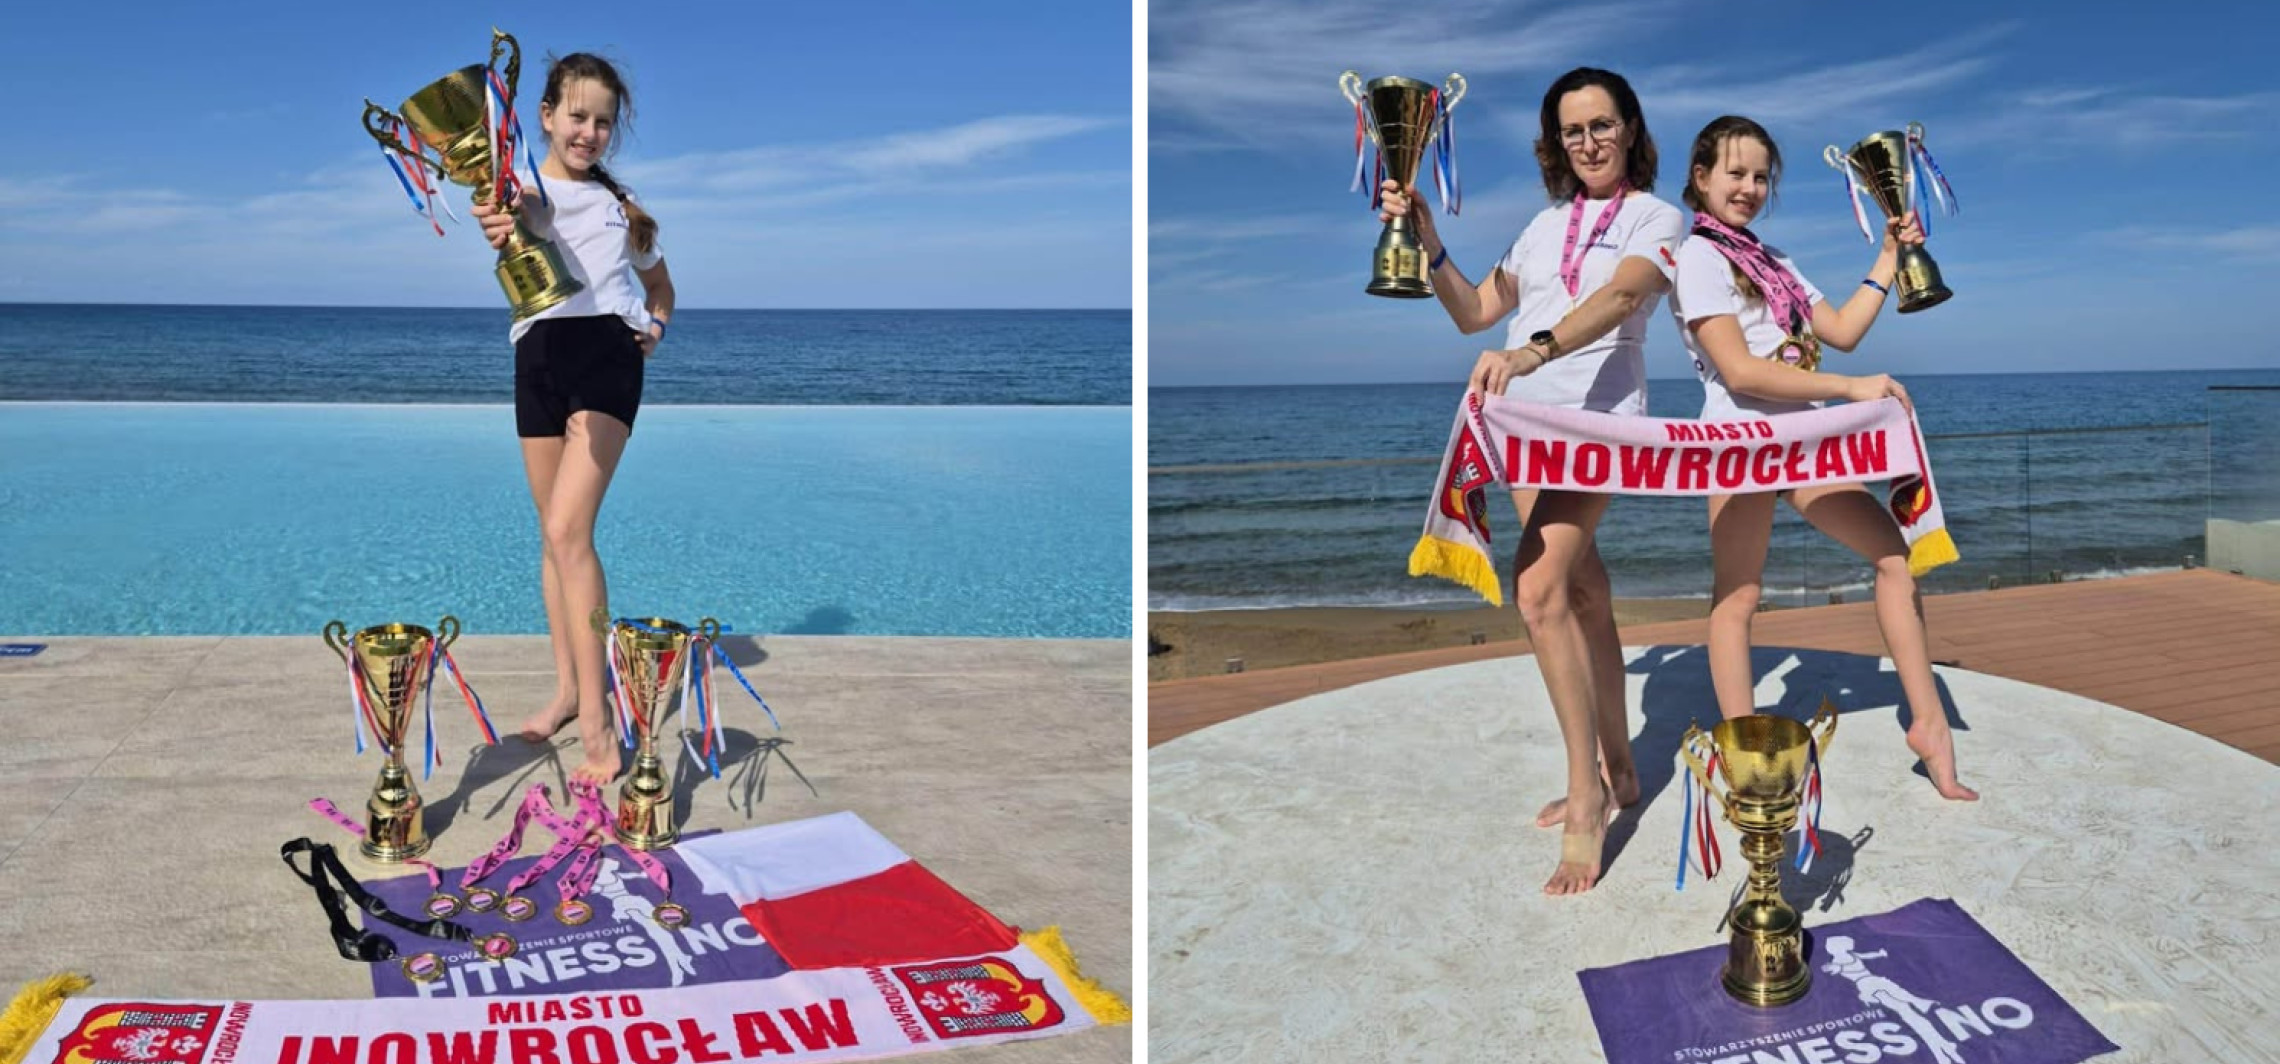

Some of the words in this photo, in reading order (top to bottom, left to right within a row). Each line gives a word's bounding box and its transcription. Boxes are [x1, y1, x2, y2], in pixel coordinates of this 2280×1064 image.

[1664, 420, 1774, 442] MIASTO
[1506, 429, 1888, 490] INOWROCŁAW
[559, 923, 634, 948] SPORTOWE
[278, 998, 859, 1064] INOWROCŁAW
[487, 994, 644, 1025] MIASTO
[1935, 997, 2035, 1043] NO
[1674, 1027, 1807, 1062] STOWARZYSZENIE
[1806, 1008, 1886, 1036] SPORTOWE
